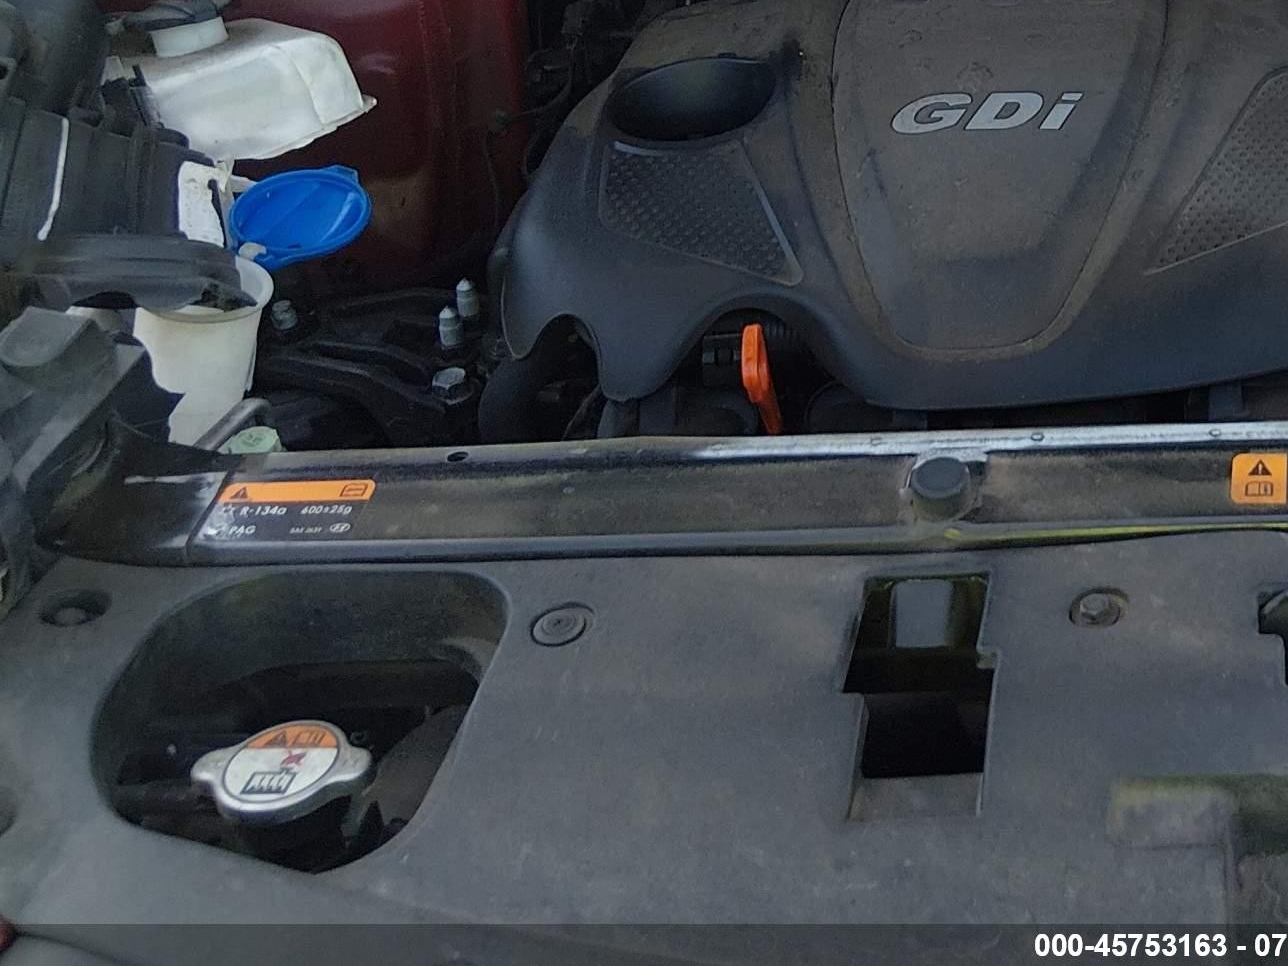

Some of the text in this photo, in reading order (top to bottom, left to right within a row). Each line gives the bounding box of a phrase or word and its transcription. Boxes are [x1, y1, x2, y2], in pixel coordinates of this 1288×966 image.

[891, 92, 1084, 134] GDi
[240, 505, 288, 516] R-134a
[229, 525, 256, 536] PAG
